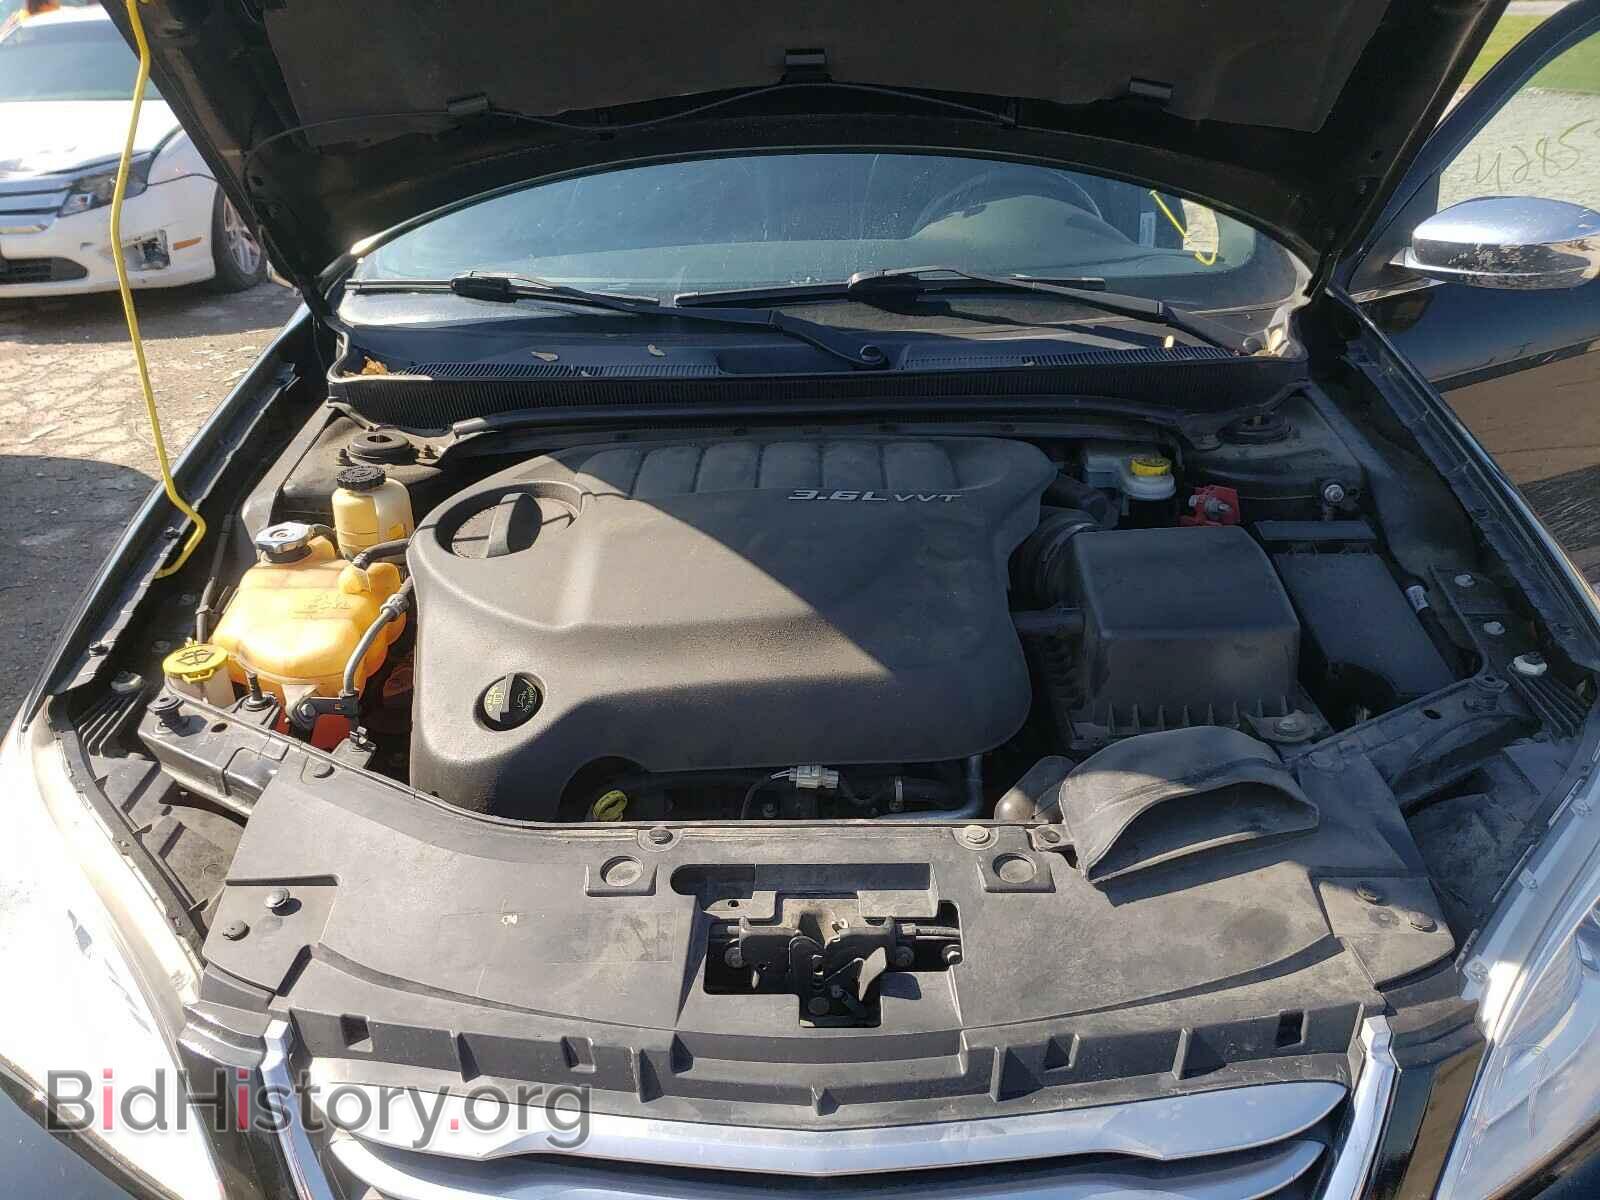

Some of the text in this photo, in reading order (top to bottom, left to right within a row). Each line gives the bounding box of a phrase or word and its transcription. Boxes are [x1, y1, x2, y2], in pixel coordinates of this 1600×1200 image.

[1475, 118, 1600, 192] 4285
[787, 489, 963, 503] 3.6L VVT
